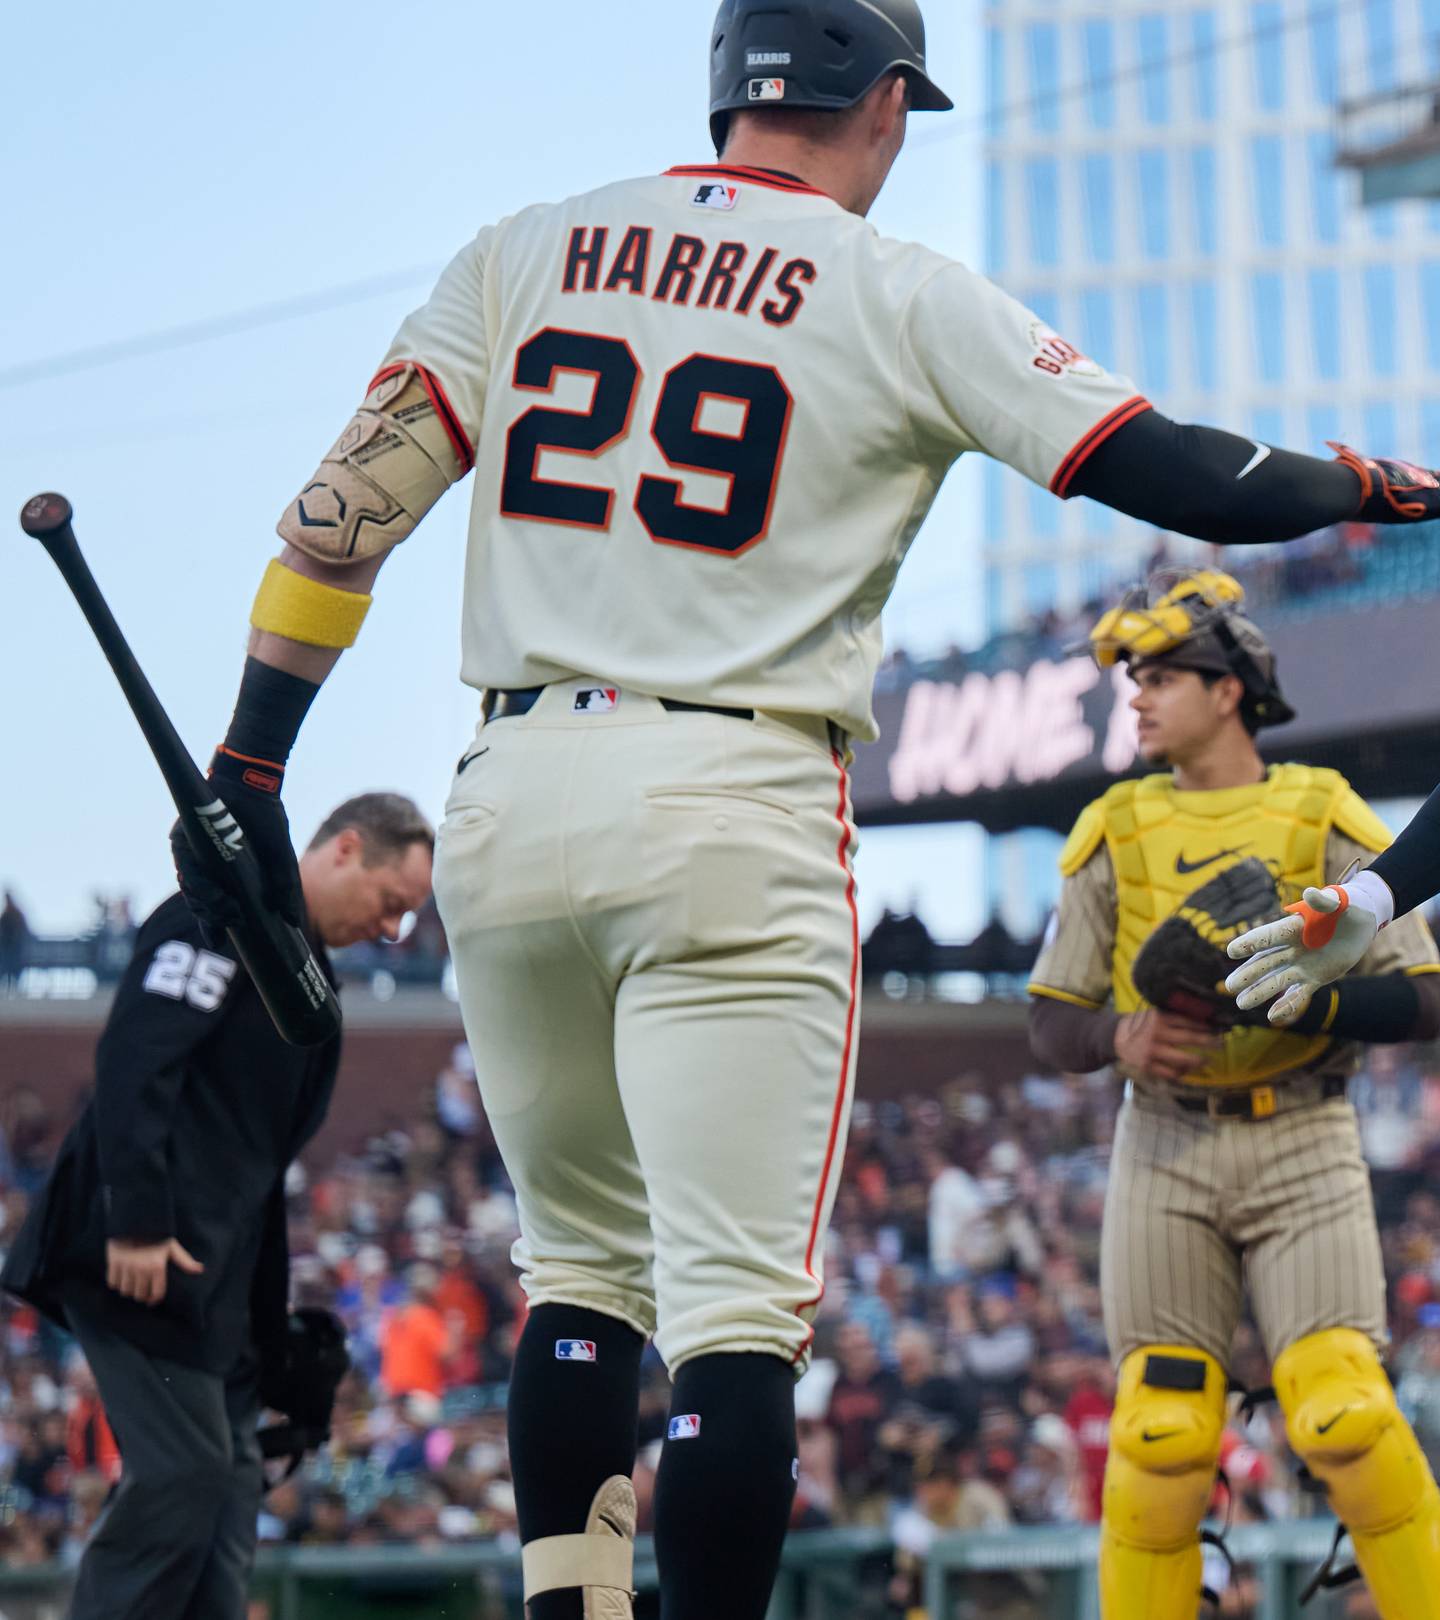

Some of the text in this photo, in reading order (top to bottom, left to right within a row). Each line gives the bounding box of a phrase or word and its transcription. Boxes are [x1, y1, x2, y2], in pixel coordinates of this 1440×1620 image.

[747, 52, 791, 66] HARRIS
[561, 225, 818, 328] HARRIS
[500, 325, 796, 559] 29
[142, 939, 238, 1013] 25
